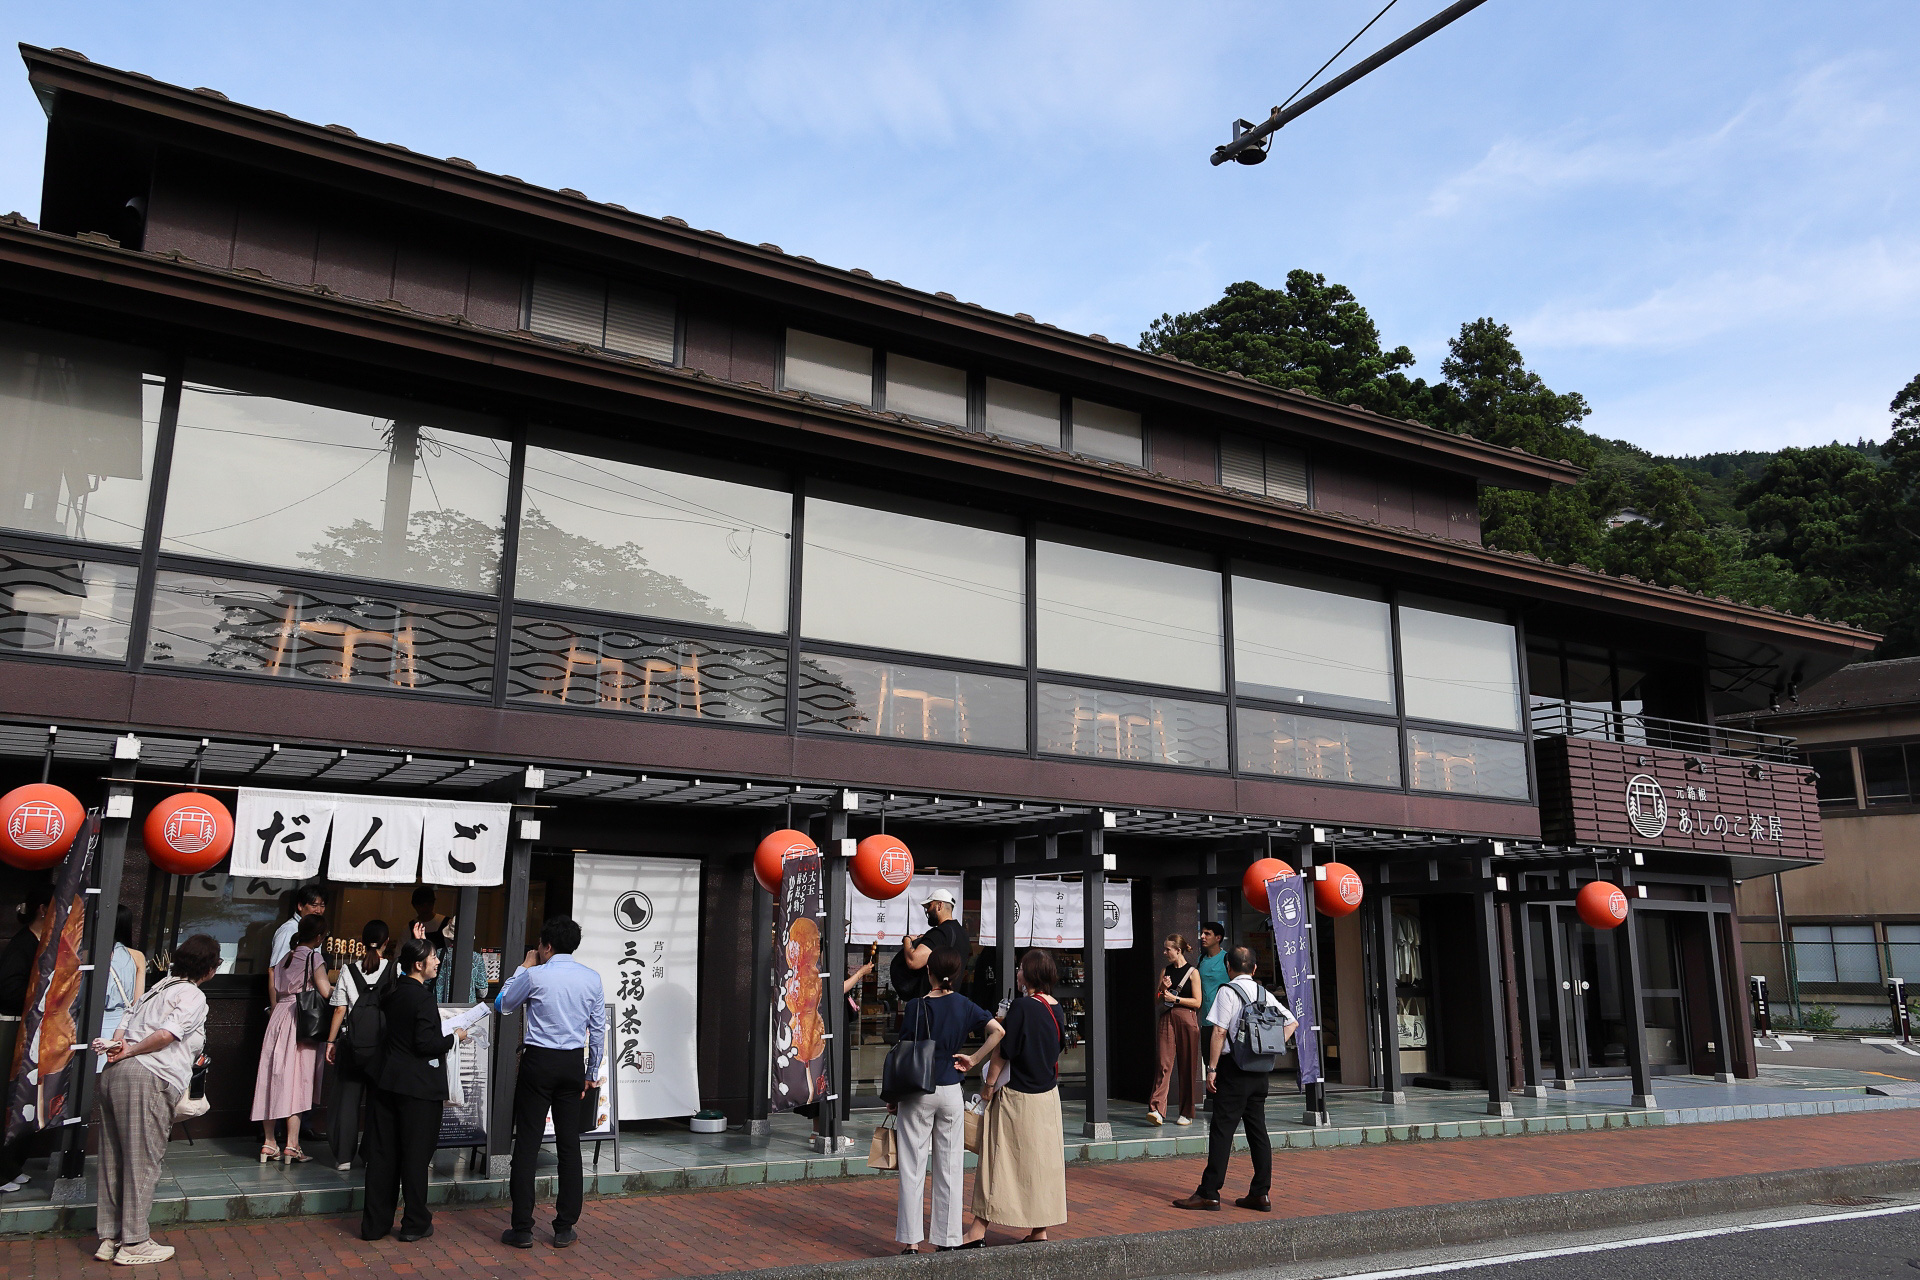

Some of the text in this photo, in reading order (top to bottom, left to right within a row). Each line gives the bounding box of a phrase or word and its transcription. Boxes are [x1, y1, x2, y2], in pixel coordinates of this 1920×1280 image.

[1675, 785, 1708, 802] 元箱根
[256, 810, 489, 874] だんご
[1678, 808, 1785, 842] あしのこ茶屋
[806, 870, 817, 896] 大玉
[876, 899, 886, 923] 土産
[1055, 891, 1065, 928] お土産
[652, 940, 665, 979] 芦ノ湖
[1283, 940, 1305, 1019] お土産
[616, 940, 646, 1070] 三福茶屋
